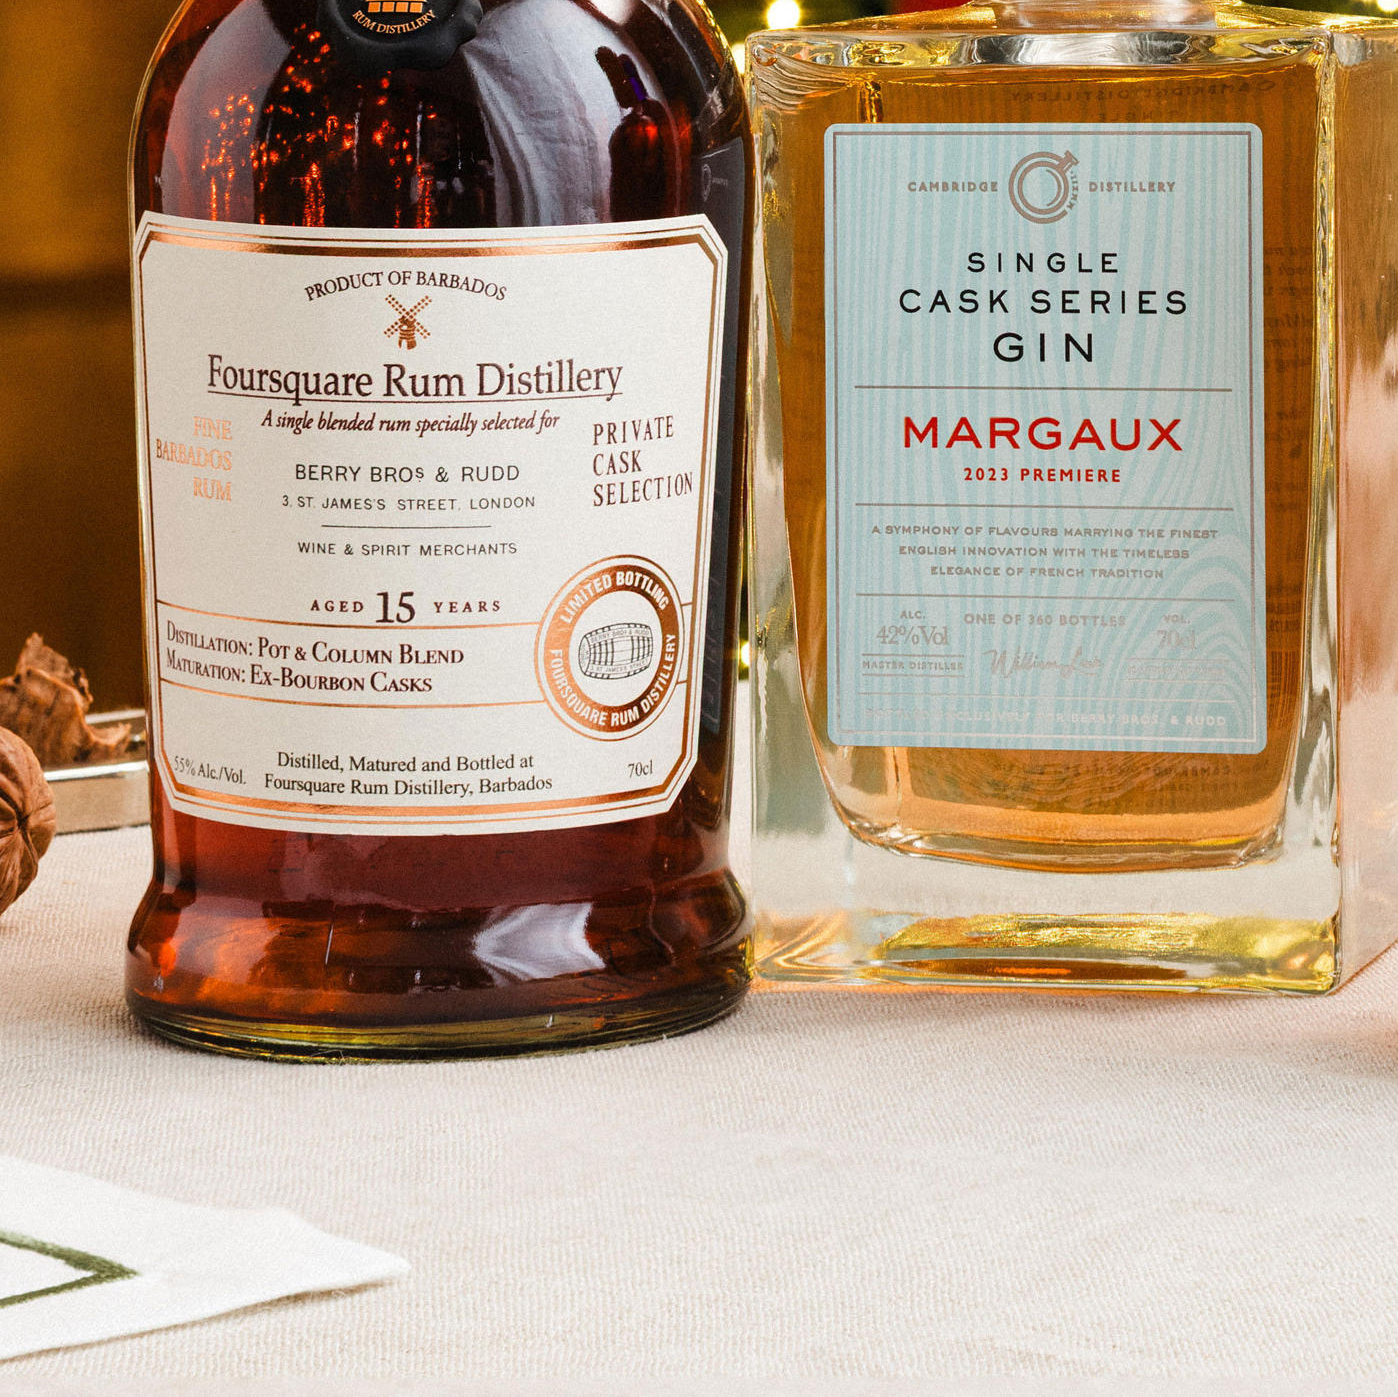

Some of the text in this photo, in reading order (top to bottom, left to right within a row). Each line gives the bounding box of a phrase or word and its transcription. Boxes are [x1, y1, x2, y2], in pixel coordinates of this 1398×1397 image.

[352, 9, 436, 34] RUM DISTILLERY
[907, 181, 1176, 194] CAMBRIDGE DISTILLERY
[967, 252, 1119, 273] SINGLE
[304, 271, 507, 302] PRODUCT OF BARBADOS
[899, 289, 1187, 316] CASK SERIES
[993, 332, 1094, 363] GIN
[208, 354, 624, 406] Foursquare Rum Distillery
[193, 416, 233, 441] FINE
[261, 409, 560, 437] A single blended rum specially selected for
[593, 415, 674, 446] PRIVATE
[903, 415, 1183, 452] MARGAUX
[156, 439, 233, 471] BARBADOS
[593, 449, 642, 477] CASK
[295, 464, 361, 482] BERRY
[435, 467, 449, 482] &
[462, 465, 520, 483] RUDD
[963, 467, 1122, 484] 2023 PREMIERE
[192, 477, 232, 501] RUM
[593, 472, 693, 507] SELECTION
[322, 498, 386, 511] JAMES'S
[470, 496, 536, 511] LONDON
[871, 525, 1219, 539] A SYMPHONY OF FLAVOURS MARRYING THE FINEST
[298, 542, 518, 557] WINE & SPIRIT MERCHANTS
[899, 545, 1190, 559] ENGLISH INNOVATION WITH THE TIMELESS
[930, 566, 1164, 579] ELEGANCE OF FRENCH TRADITION
[311, 591, 501, 624] AGED 15 YEARS
[559, 571, 670, 623] LIMITED BOTTLING
[900, 610, 926, 620] ALC.
[963, 613, 1126, 627] ONE OF 360 BOTTLES
[294, 646, 307, 660] &
[862, 661, 905, 670] MASTER
[551, 634, 676, 727] FOURSQUARE RUM DISTILLERY
[1185, 715, 1226, 726] RUDD
[174, 755, 247, 785] 55% Alc./Vol.
[278, 752, 534, 773] Distilled, Matured and Bottled at
[627, 760, 653, 778] 70cl
[264, 773, 553, 798] Foursquare Rum Distillery, Barbados
